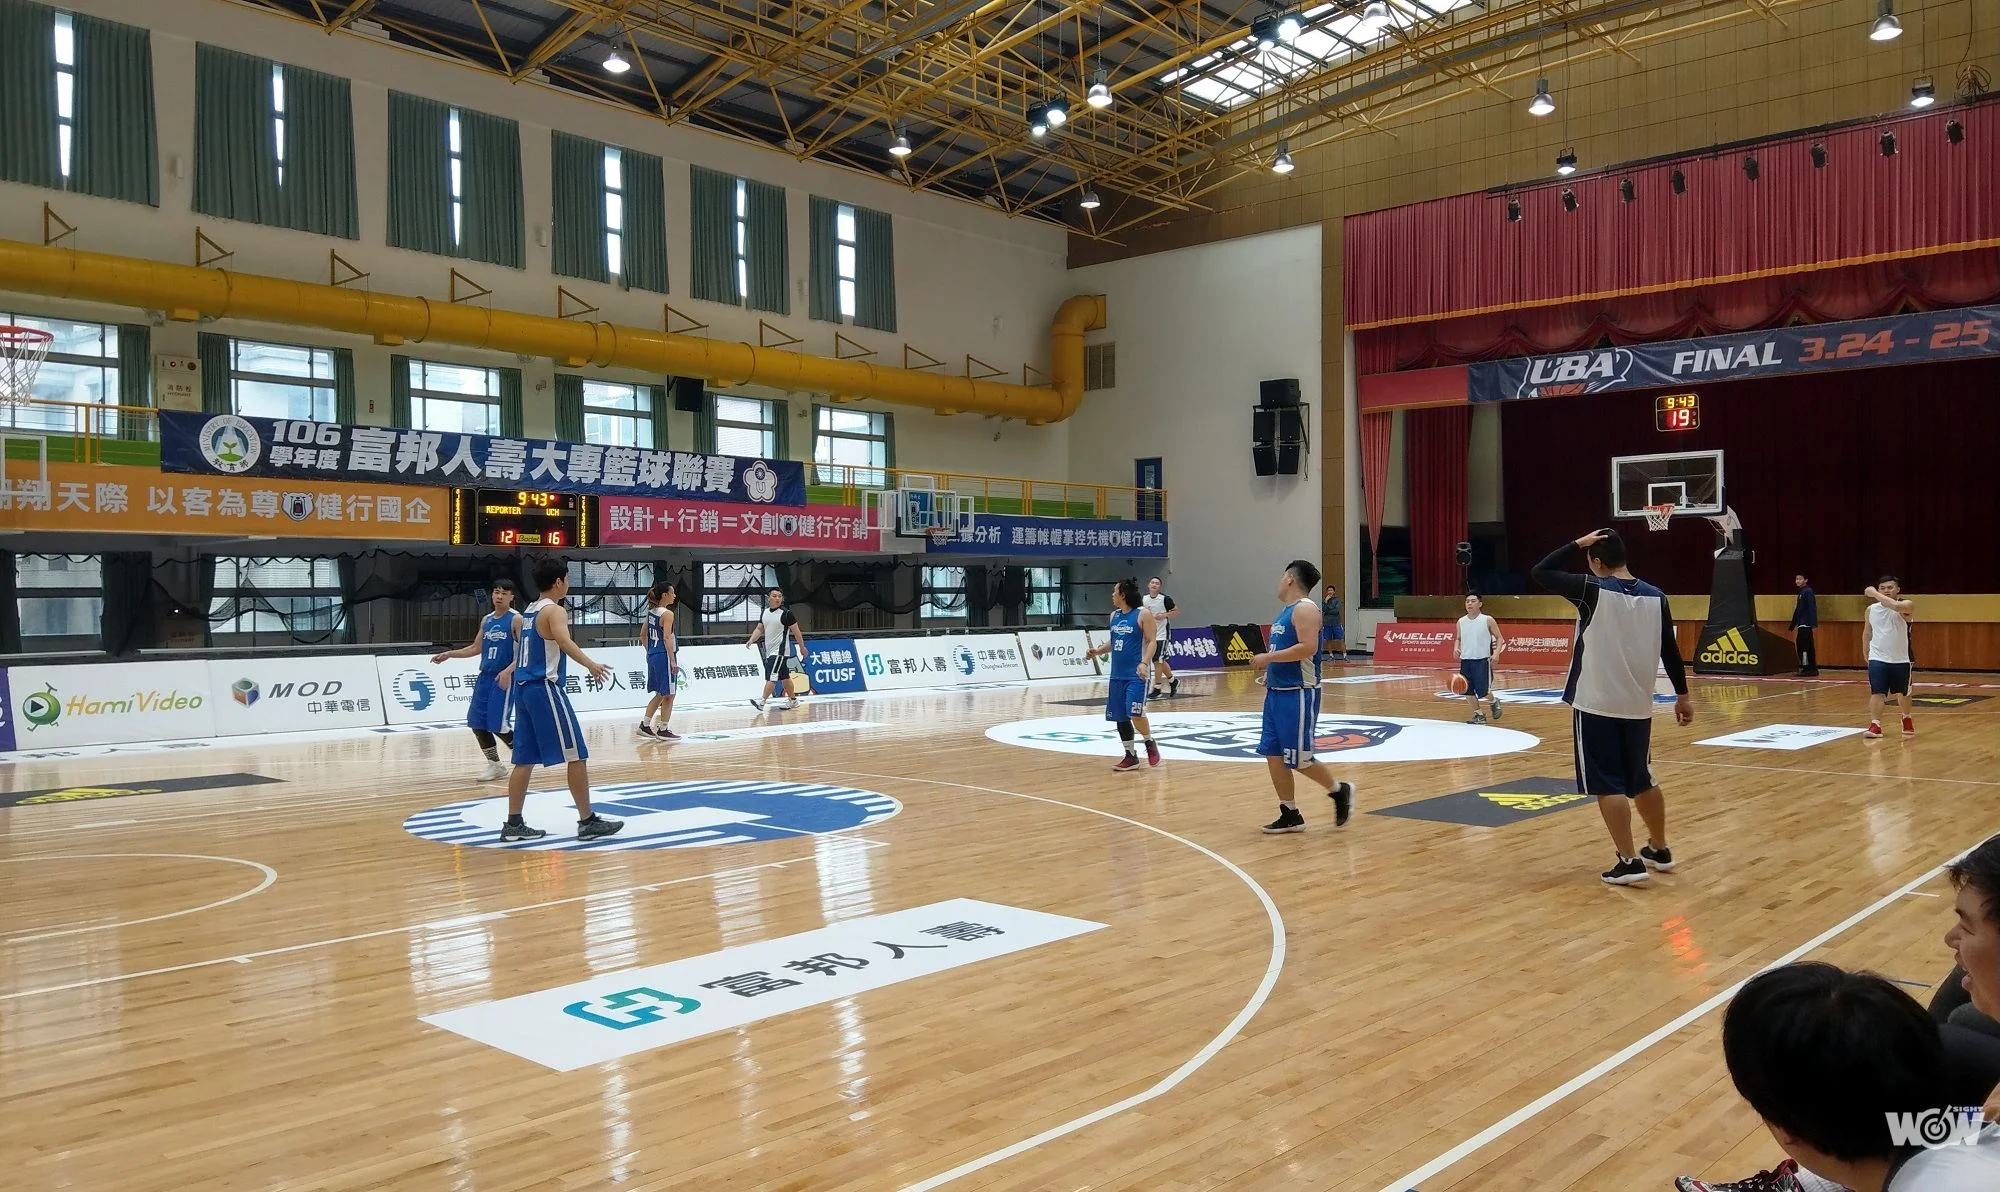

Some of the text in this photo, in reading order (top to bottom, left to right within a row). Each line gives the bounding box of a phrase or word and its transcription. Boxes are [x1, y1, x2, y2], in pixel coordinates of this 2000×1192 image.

[1672, 342, 1783, 375] FINAL
[1799, 330, 1894, 362] 3.24
[1929, 320, 1992, 350] 25
[1530, 352, 1614, 384] UBA
[1667, 396, 1695, 409] 9:43
[1671, 409, 1690, 427] 19
[272, 420, 342, 446] 106
[269, 445, 341, 470] 學年度
[347, 425, 735, 495] 富邦人壽大專籃球聯賽
[147, 485, 280, 519] 以客為尊
[315, 493, 431, 524] 健行國企
[518, 491, 547, 506] 9:43
[486, 505, 521, 515] REPORTER
[799, 515, 869, 540] 健行行銷
[501, 530, 513, 543] 12
[548, 532, 560, 545] 16
[810, 650, 853, 666] 大專體總
[978, 649, 1016, 661] 中華電信
[1046, 646, 1075, 656] MOD
[1227, 651, 1255, 660] adidas
[1700, 650, 1759, 665] adidas
[693, 664, 760, 680] 教育部體育署
[887, 657, 947, 674] 富邦人壽
[565, 671, 647, 694] 富邦人壽
[815, 668, 856, 684] CTUSF
[269, 680, 343, 699] MOD
[308, 698, 371, 715] 中華電信
[1131, 701, 1144, 714] 29
[1284, 748, 1297, 765] 21
[698, 920, 1006, 998] 富邦人壽
